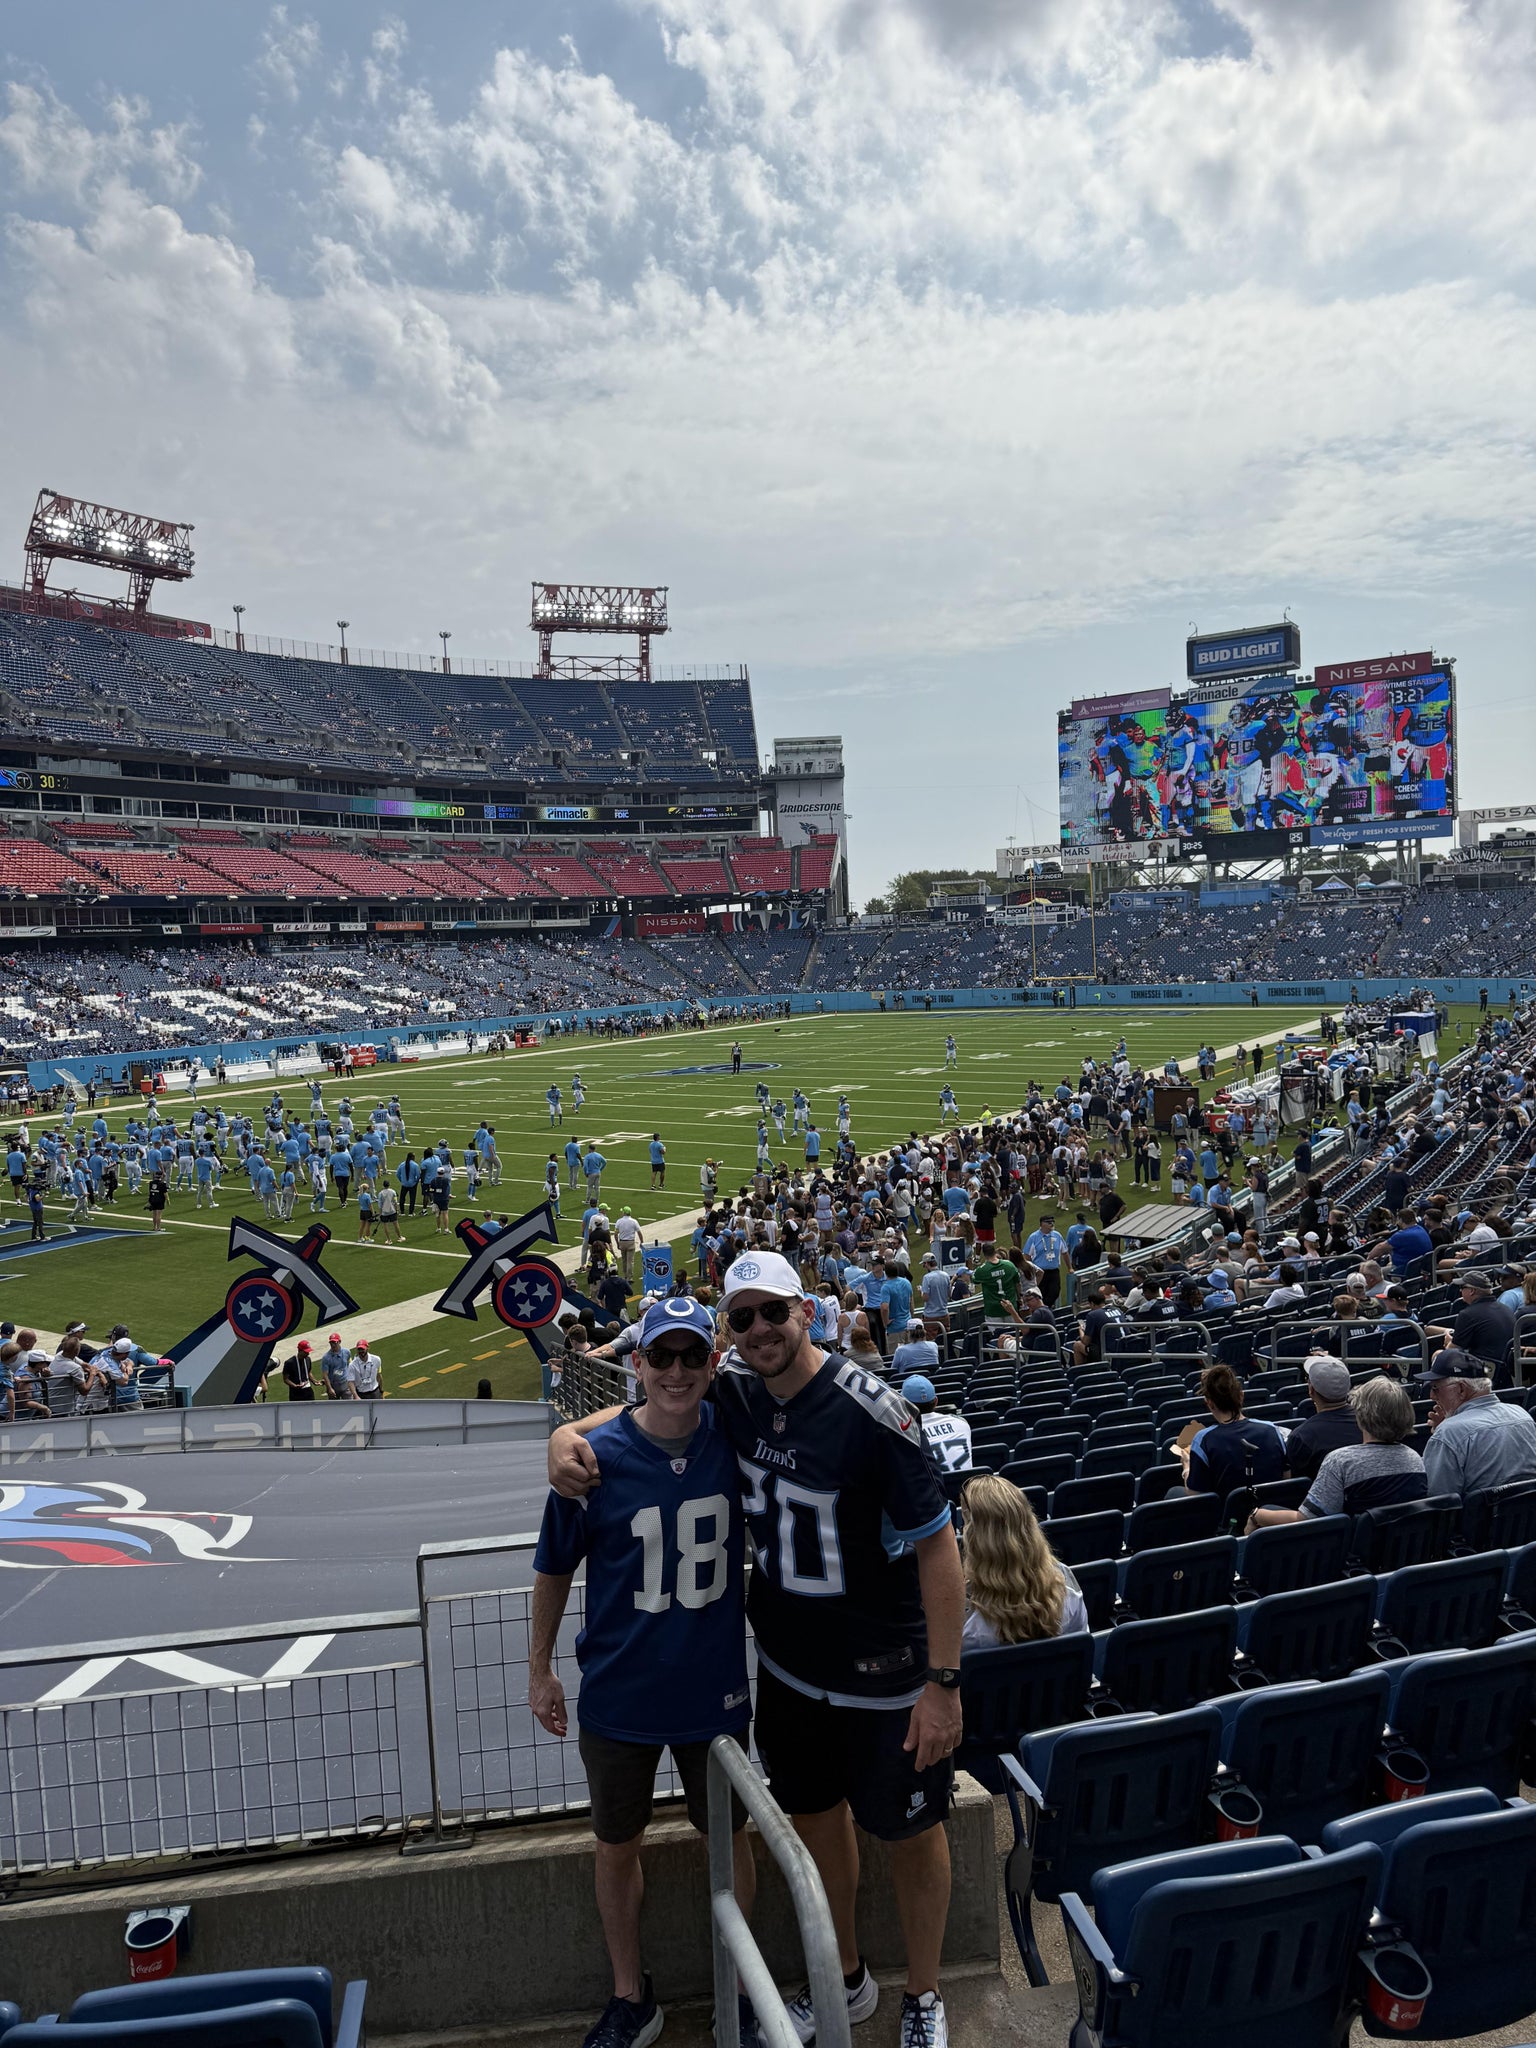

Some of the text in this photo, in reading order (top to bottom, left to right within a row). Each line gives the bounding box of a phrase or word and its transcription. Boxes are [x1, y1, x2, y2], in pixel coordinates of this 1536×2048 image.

[1198, 641, 1279, 664] BUD LIGHT
[1330, 659, 1416, 681] NISSAN
[1189, 685, 1239, 703] Pinnacle
[1090, 703, 1120, 712] Ascension
[1120, 700, 1135, 708] Saint
[440, 806, 465, 816] CARD
[548, 807, 589, 819] Pinnacle
[779, 803, 843, 814] BRIDGESTONE
[614, 811, 630, 819] FDIC
[1333, 827, 1359, 841] Kroger
[1362, 828, 1383, 836] FRESH
[1006, 844, 1062, 857] NISSAN
[1064, 846, 1090, 858] MARS
[1008, 907, 1026, 915] ROCKY
[646, 918, 697, 927] NISSAN
[1130, 990, 1162, 999] TENNESSEE
[1267, 987, 1301, 997] TENNESSEE
[376, 1113, 385, 1121] 91
[948, 1246, 959, 1262] C
[995, 1278, 1006, 1296] 1
[923, 1421, 954, 1440] ALKER
[753, 1437, 797, 1470] TITANS
[630, 1493, 730, 1614] 18
[135, 1959, 164, 1974] Coca-Cola
